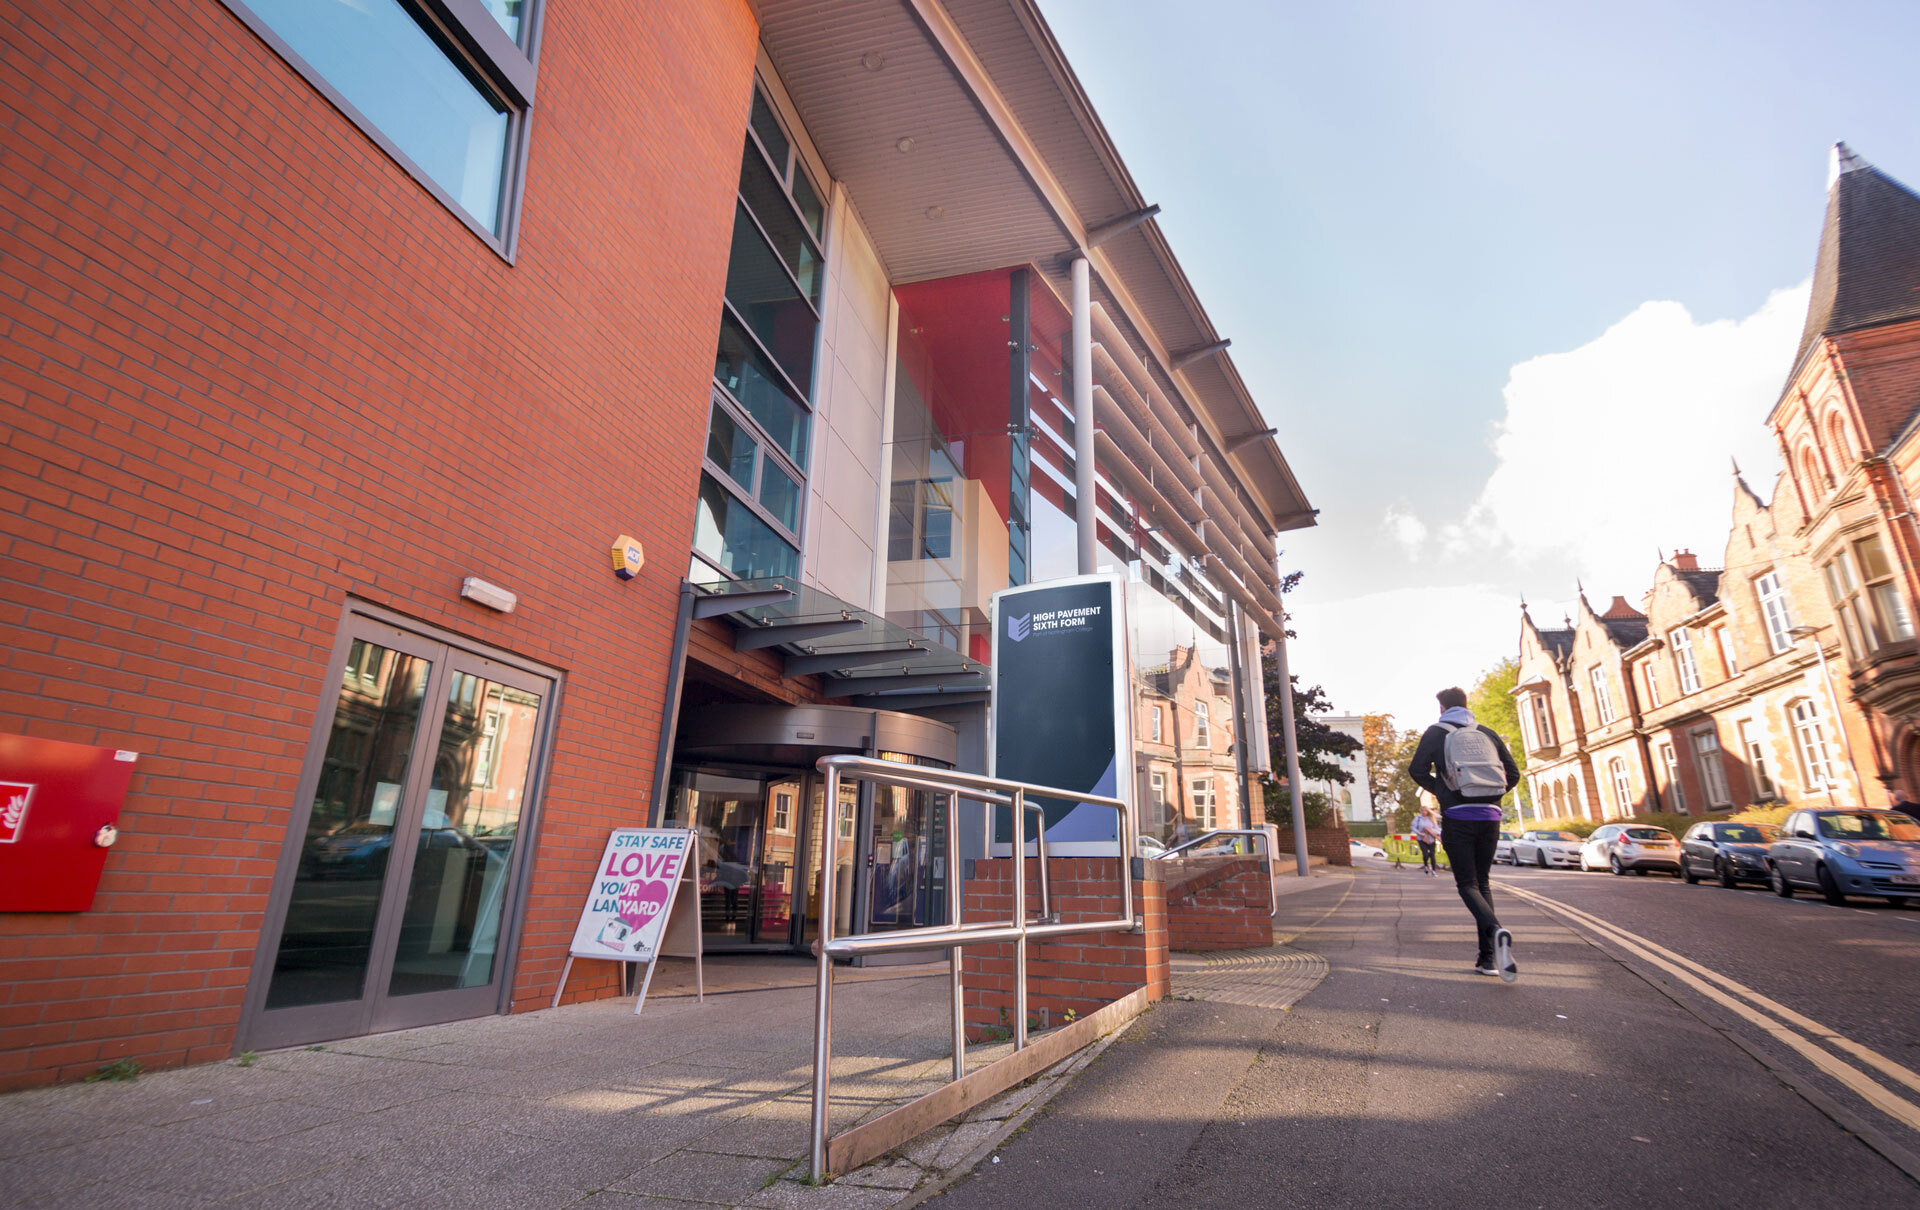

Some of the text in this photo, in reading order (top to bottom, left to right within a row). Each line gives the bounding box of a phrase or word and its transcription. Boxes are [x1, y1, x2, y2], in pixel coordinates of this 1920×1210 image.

[1033, 606, 1101, 622] HIGH PAVEMENT
[1033, 617, 1086, 631] SIXTH FORM
[615, 834, 685, 850] STAY SAFE
[605, 852, 680, 878] LOVE
[600, 881, 640, 897] YOUR
[592, 898, 660, 916] LANYARD
